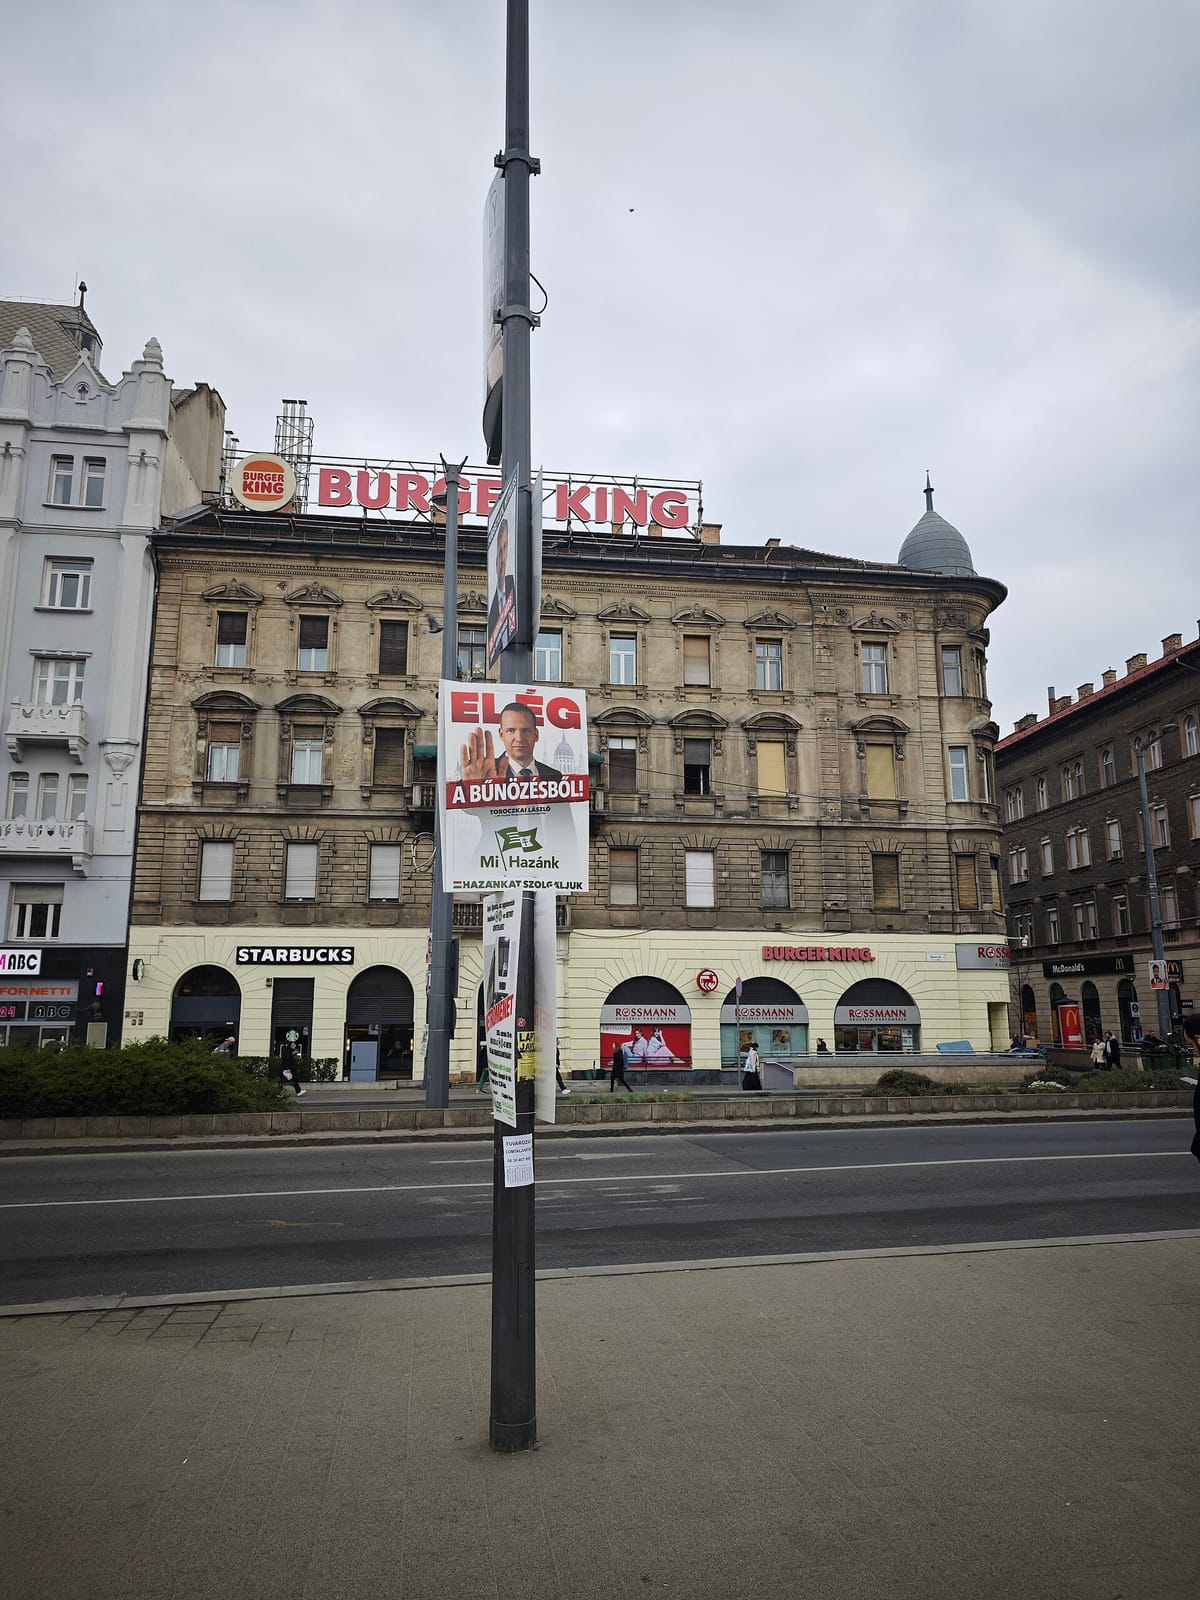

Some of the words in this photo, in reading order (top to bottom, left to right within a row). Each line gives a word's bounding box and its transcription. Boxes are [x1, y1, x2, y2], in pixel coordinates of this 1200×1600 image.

[243, 472, 284, 482] BURGER
[242, 482, 284, 495] KING
[318, 468, 534, 516] BURGE
[556, 484, 689, 528] KING
[451, 689, 581, 730] ELÉG
[452, 786, 465, 804] A
[470, 776, 584, 803] BŰNÖZÉSBŐL!
[481, 856, 499, 868] Mi
[509, 856, 559, 869] Hazánk
[238, 948, 352, 963] STARBUCKS
[763, 946, 827, 961] BURGER
[8, 954, 38, 970] ABC
[1052, 963, 1085, 974] McDonald's
[35, 1006, 71, 1018] ABC
[615, 1008, 676, 1017] ROSSMANN
[734, 1008, 794, 1017] ROSSMANN
[848, 1009, 907, 1018] ROSSMANN
